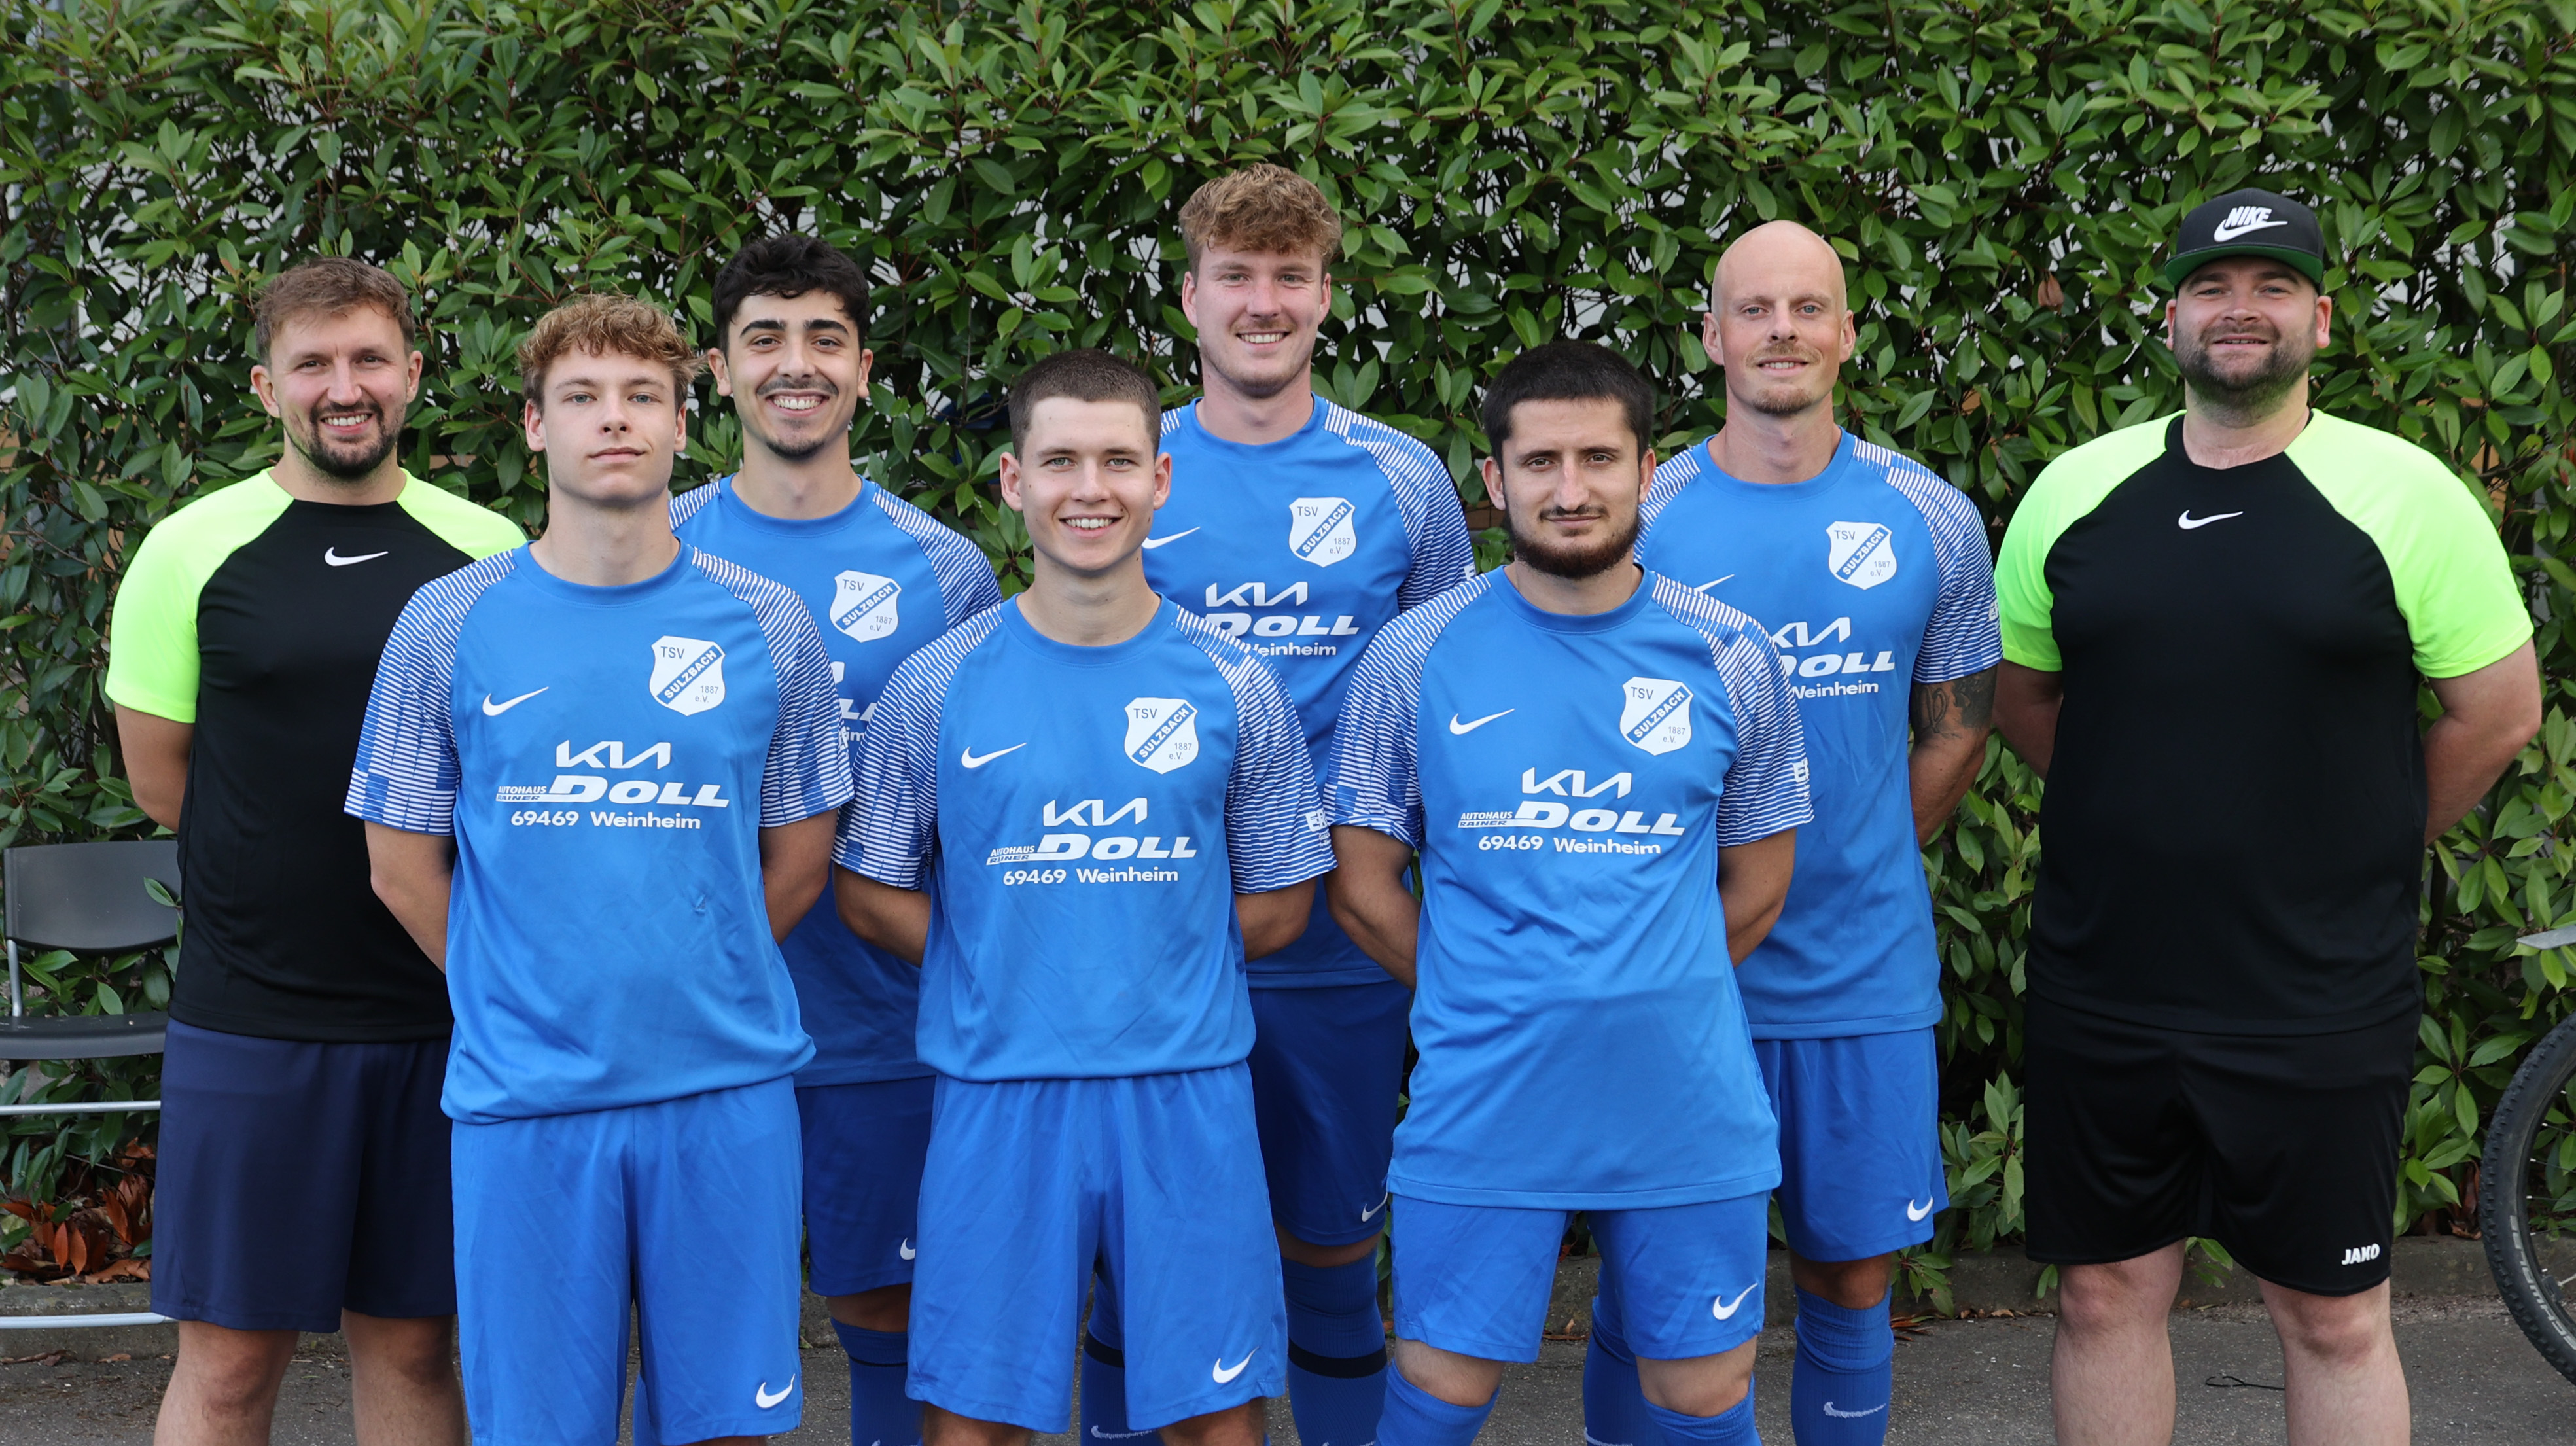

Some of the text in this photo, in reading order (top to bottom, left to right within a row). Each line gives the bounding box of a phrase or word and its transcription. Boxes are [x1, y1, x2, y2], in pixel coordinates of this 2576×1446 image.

[2224, 206, 2272, 228] NIKE
[1297, 506, 1318, 517] TSV
[1302, 504, 1348, 553] SULZBACH
[1834, 530, 1855, 540] TSV
[1842, 531, 1884, 576] SULZBACH
[842, 579, 864, 591] TSV
[1205, 582, 1308, 607] KIA
[841, 585, 894, 626] SULZBACH
[875, 616, 892, 625] 1887
[1204, 612, 1360, 637] DOLL
[660, 646, 685, 660] TSV
[664, 650, 717, 699] SULZBACH
[695, 695, 709, 704] e.V.
[700, 685, 719, 694] 1887
[1631, 687, 1654, 700] TSV
[1133, 708, 1157, 719] TSV
[1634, 691, 1685, 739] SULZBACH
[1139, 707, 1190, 758] SULZBACH
[1663, 735, 1676, 744] e.V.
[1668, 726, 1685, 735] 1887
[556, 739, 671, 770] KIA
[1174, 743, 1192, 751] 1887
[548, 775, 730, 808] DOLL
[1522, 767, 1632, 799] KIA
[511, 811, 701, 829] 69469 Weinheim
[1043, 797, 1148, 827] KIA
[1460, 811, 1513, 820] AUTOHAUS
[1514, 800, 1685, 836] DOLL
[1036, 834, 1197, 861] DOLL
[1478, 835, 1661, 855] 69469 Weinheim
[1002, 867, 1178, 886] 69469 Weinheim
[2341, 1243, 2380, 1265] JAKO
